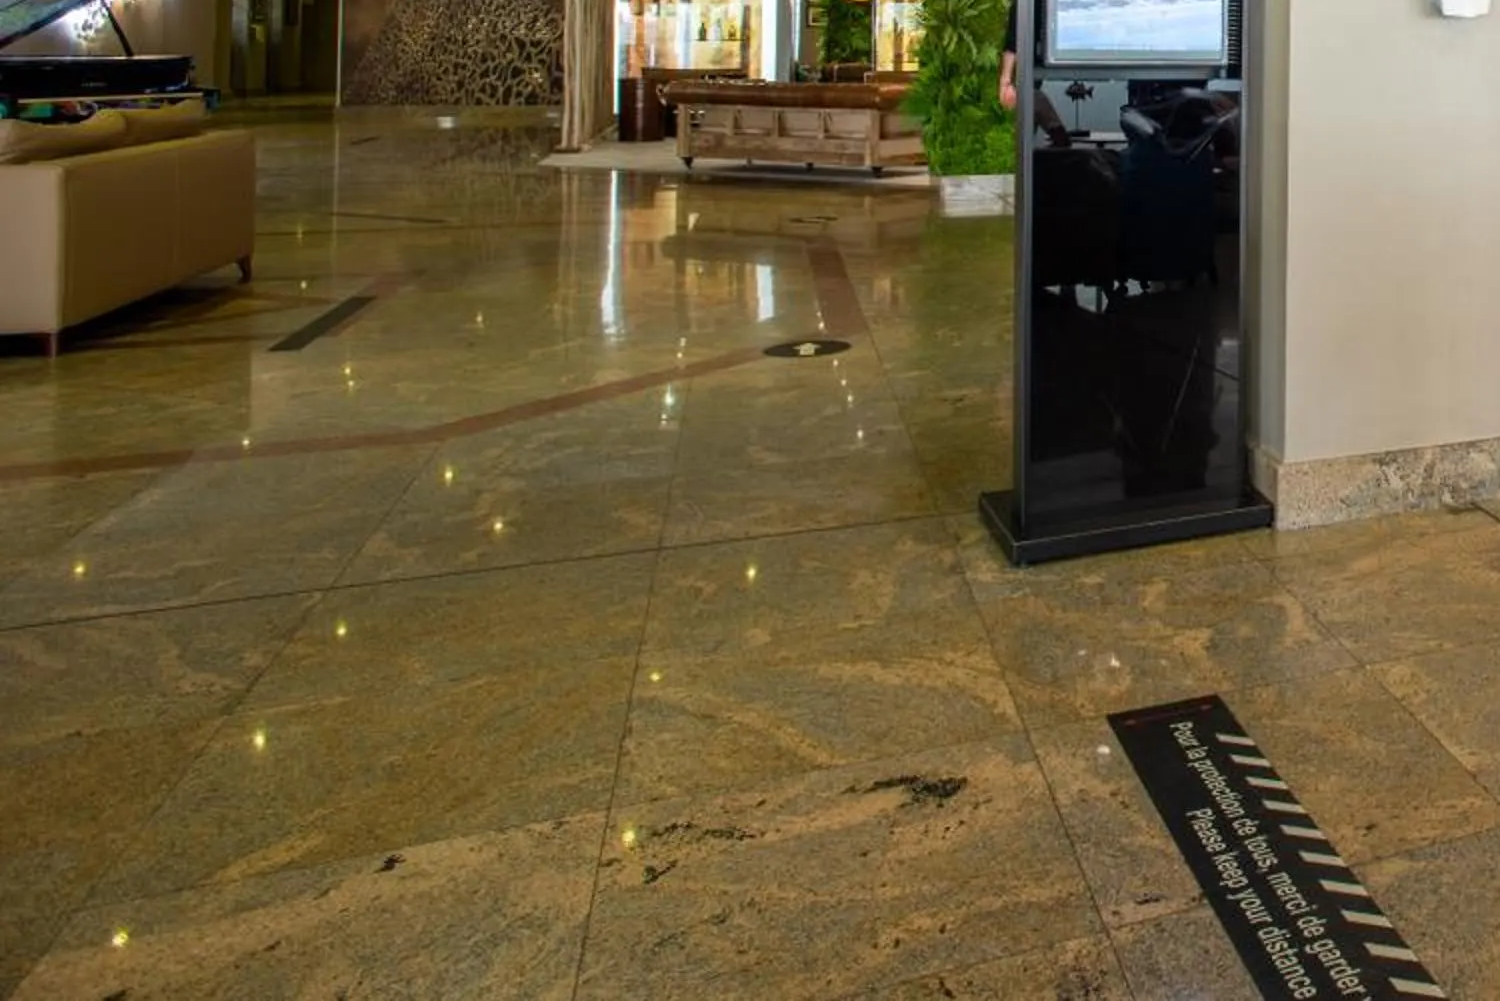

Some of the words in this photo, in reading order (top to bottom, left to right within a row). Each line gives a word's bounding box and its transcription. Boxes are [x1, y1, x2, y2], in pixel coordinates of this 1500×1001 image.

[1169, 721, 1200, 747] Pour
[1185, 745, 1209, 760] la
[1186, 759, 1245, 818] protection
[1184, 808, 1227, 853] Please
[1231, 818, 1260, 836] de
[1211, 851, 1249, 889] keep
[1243, 835, 1279, 874] tous,
[1225, 887, 1273, 925] your
[1266, 871, 1318, 916] merci
[1296, 916, 1328, 938] de
[1257, 926, 1318, 1000] distance
[1304, 939, 1368, 996] garder
